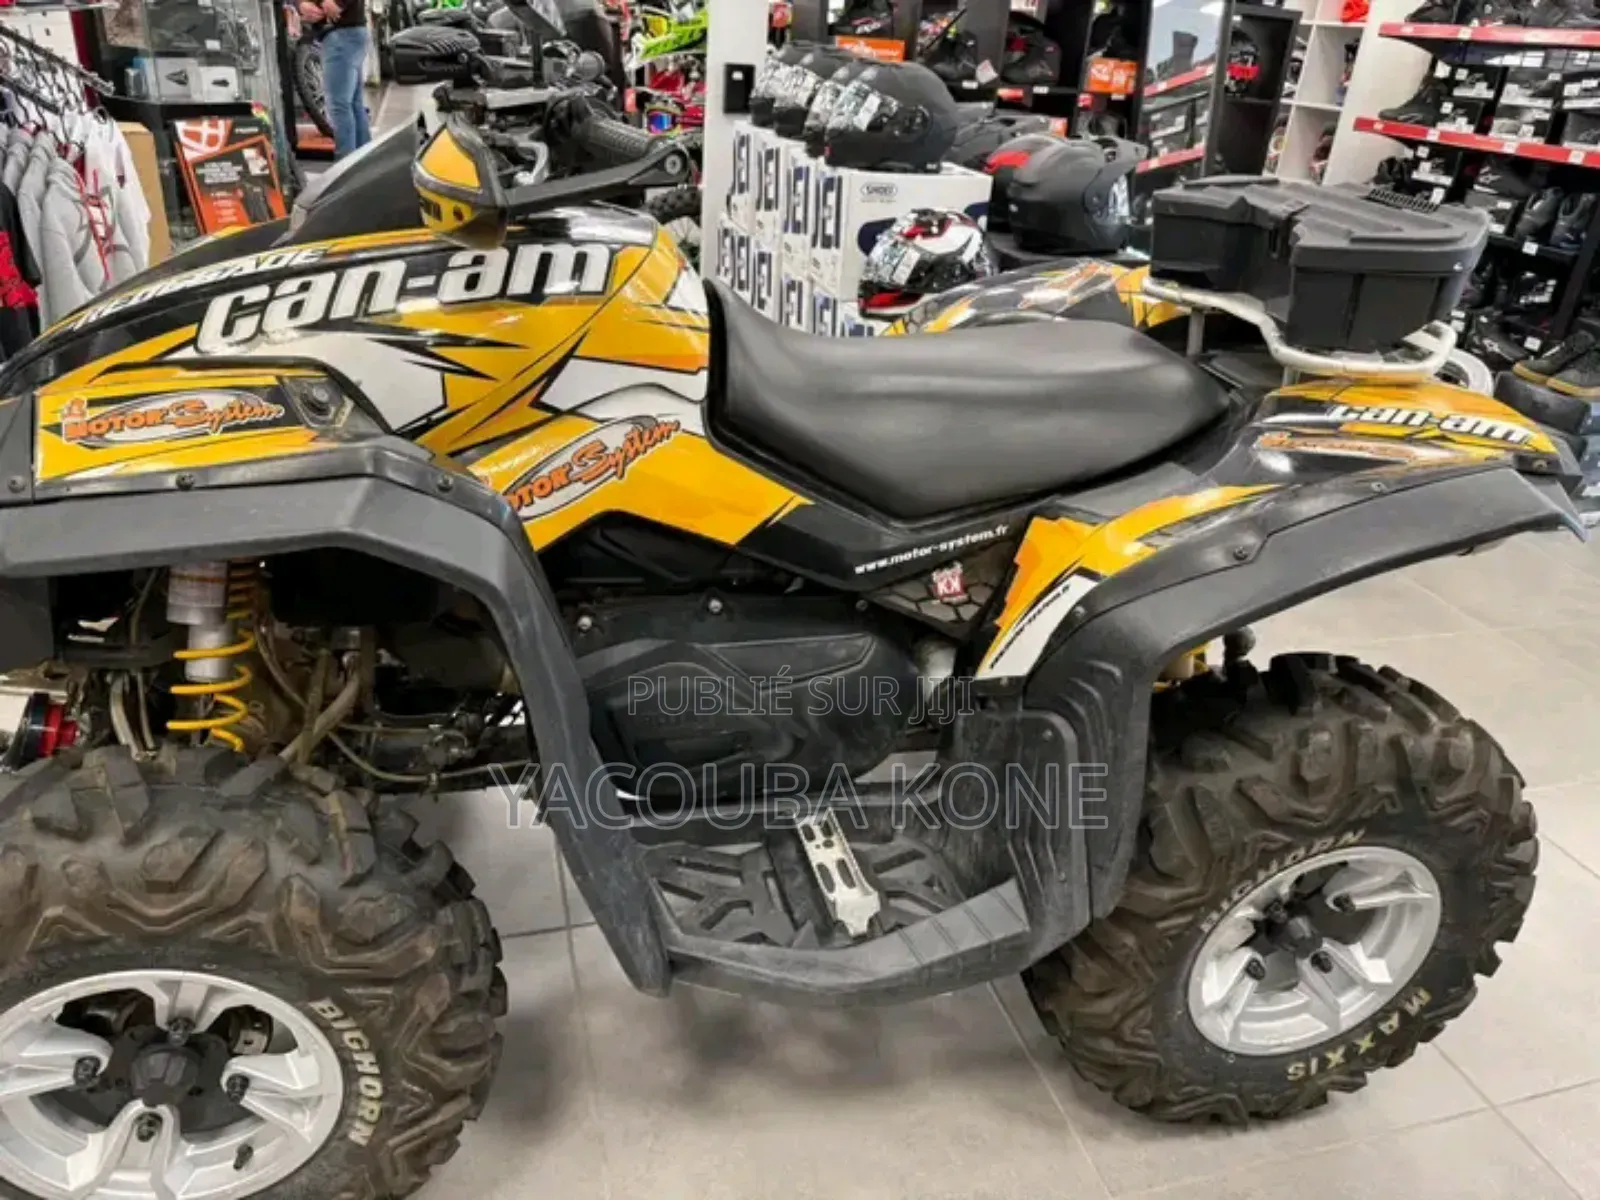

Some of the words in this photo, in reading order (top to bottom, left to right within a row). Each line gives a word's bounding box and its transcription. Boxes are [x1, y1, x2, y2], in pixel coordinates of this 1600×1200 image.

[196, 243, 612, 355] can-am
[65, 408, 168, 439] MOTOR
[1325, 403, 1530, 444] can-am
[854, 524, 1009, 575] www.motor-system.fr
[1286, 986, 1432, 1082] MAXXIS
[308, 997, 384, 1147] BIGHORN
